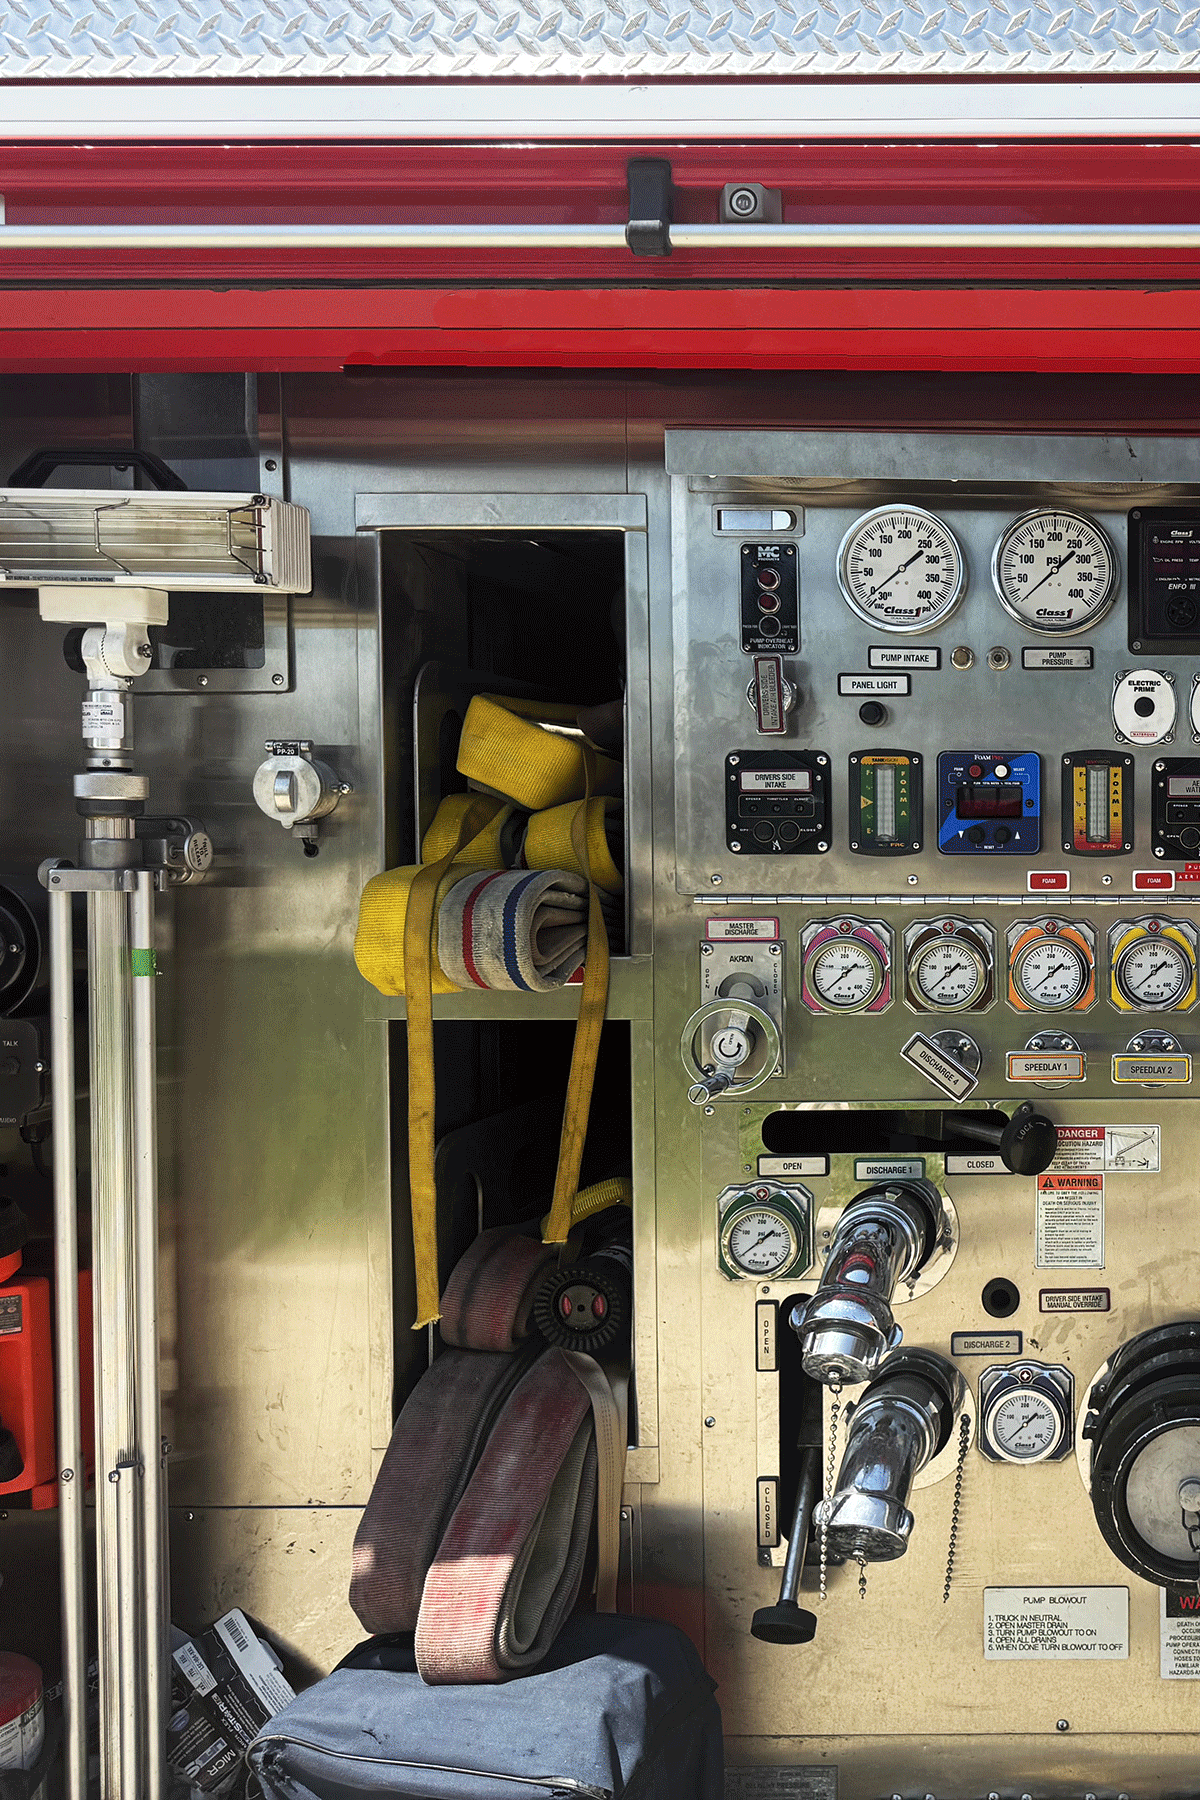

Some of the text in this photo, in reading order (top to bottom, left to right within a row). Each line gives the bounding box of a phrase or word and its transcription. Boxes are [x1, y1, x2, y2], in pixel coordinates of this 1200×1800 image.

[897, 530, 912, 539] 200
[1047, 533, 1063, 542] 200
[879, 535, 893, 544] 150
[1029, 539, 1044, 549] 150
[1067, 539, 1082, 549] 250
[918, 540, 932, 549] 250
[758, 546, 780, 558] MC
[868, 549, 882, 558] 100
[925, 555, 940, 564] 300
[1019, 555, 1034, 564] 100
[1046, 555, 1062, 565] psi
[1075, 555, 1091, 564] 300
[863, 568, 874, 577] 50
[1077, 572, 1093, 582] 350
[925, 574, 940, 583] 350
[1017, 573, 1028, 583] 50
[870, 586, 875, 595] 0
[917, 590, 931, 599] 400
[1068, 589, 1084, 598] 400
[922, 606, 932, 614] psi
[881, 654, 930, 663] PUMP INTAKE
[1042, 658, 1074, 666] PRESSURE
[851, 681, 897, 689] PANEL LIGHT
[1112, 773, 1120, 804] FOAM
[919, 1050, 959, 1086] DISCHARGE 4
[1024, 1063, 1067, 1071] SPEEDLAY 1
[1130, 1066, 1172, 1074] SPEEDLAY 2
[1058, 1130, 1098, 1138] DANGER
[967, 1161, 995, 1169] CLOSED
[866, 1166, 912, 1175] DISCHARGE 1
[1057, 1178, 1098, 1187] WARNING
[964, 1341, 1004, 1349] DISCHARGE
